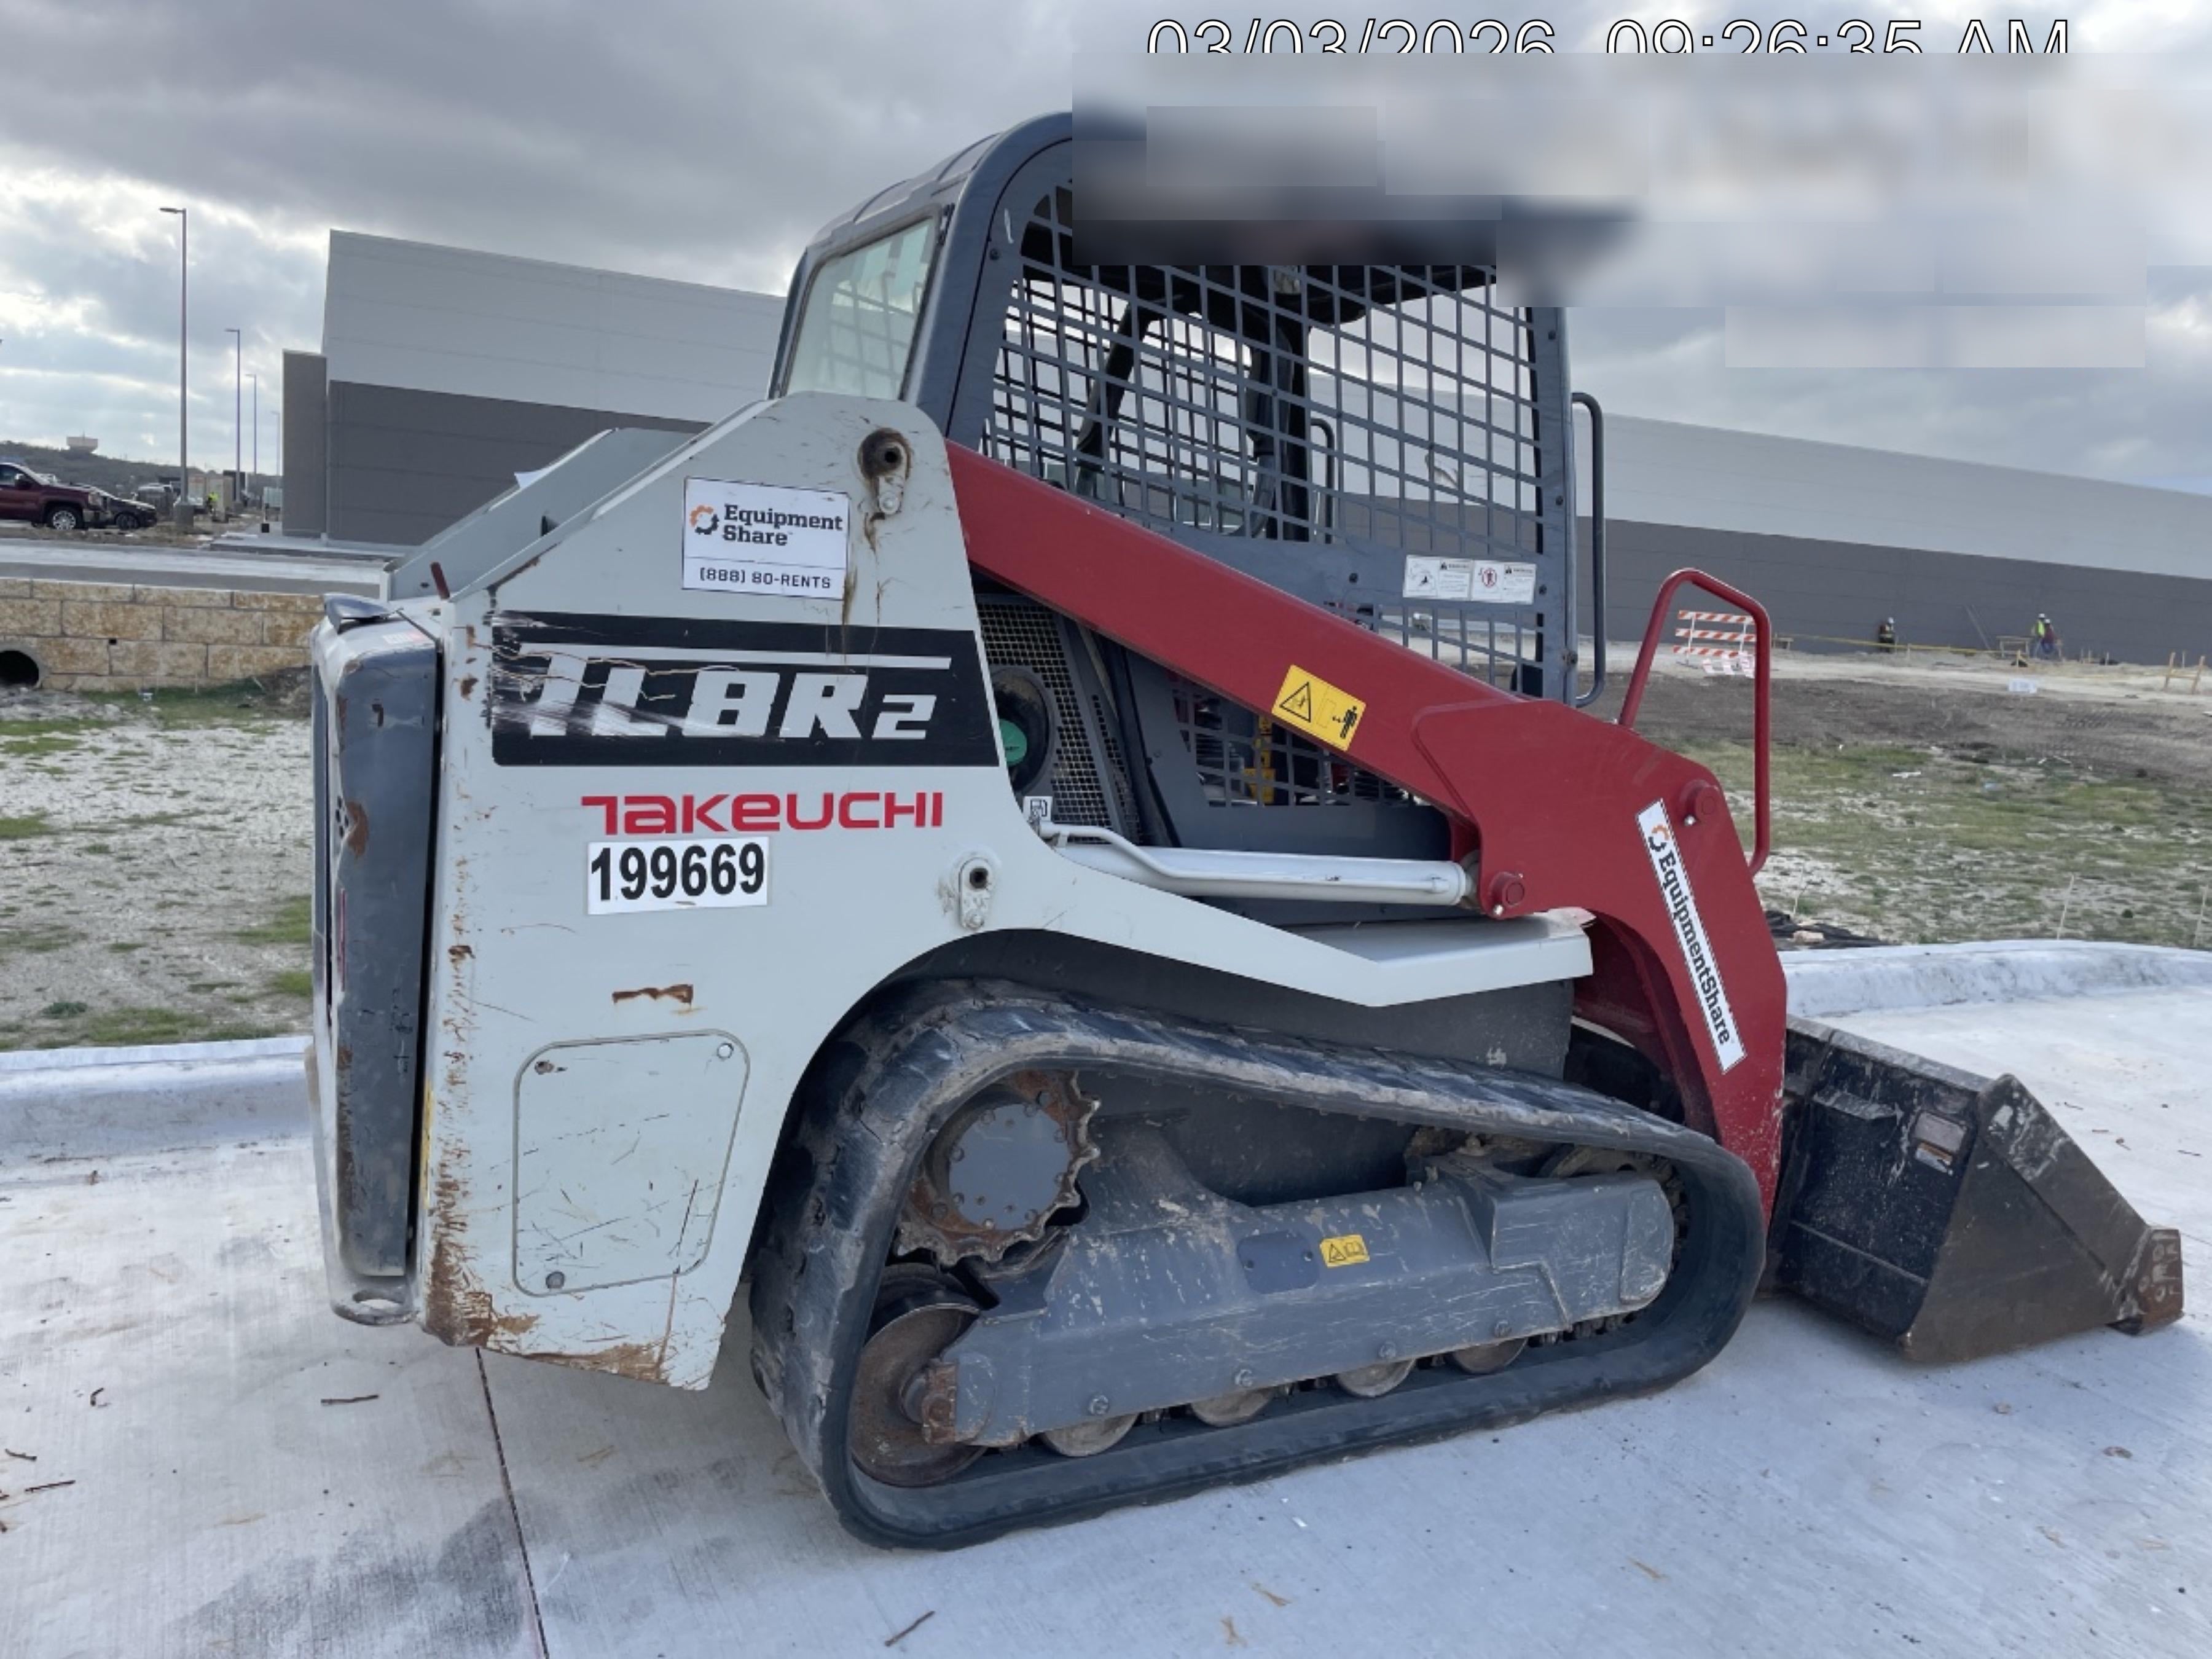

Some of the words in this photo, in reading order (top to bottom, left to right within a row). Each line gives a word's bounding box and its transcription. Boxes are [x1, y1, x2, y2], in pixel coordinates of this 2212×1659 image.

[724, 504, 843, 530] Equipment
[723, 525, 788, 546] Share
[700, 567, 745, 583] (888)
[751, 573, 831, 589] 80-RENTS
[590, 842, 766, 901] 199669
[1659, 850, 1730, 1045] EquipmentShare
